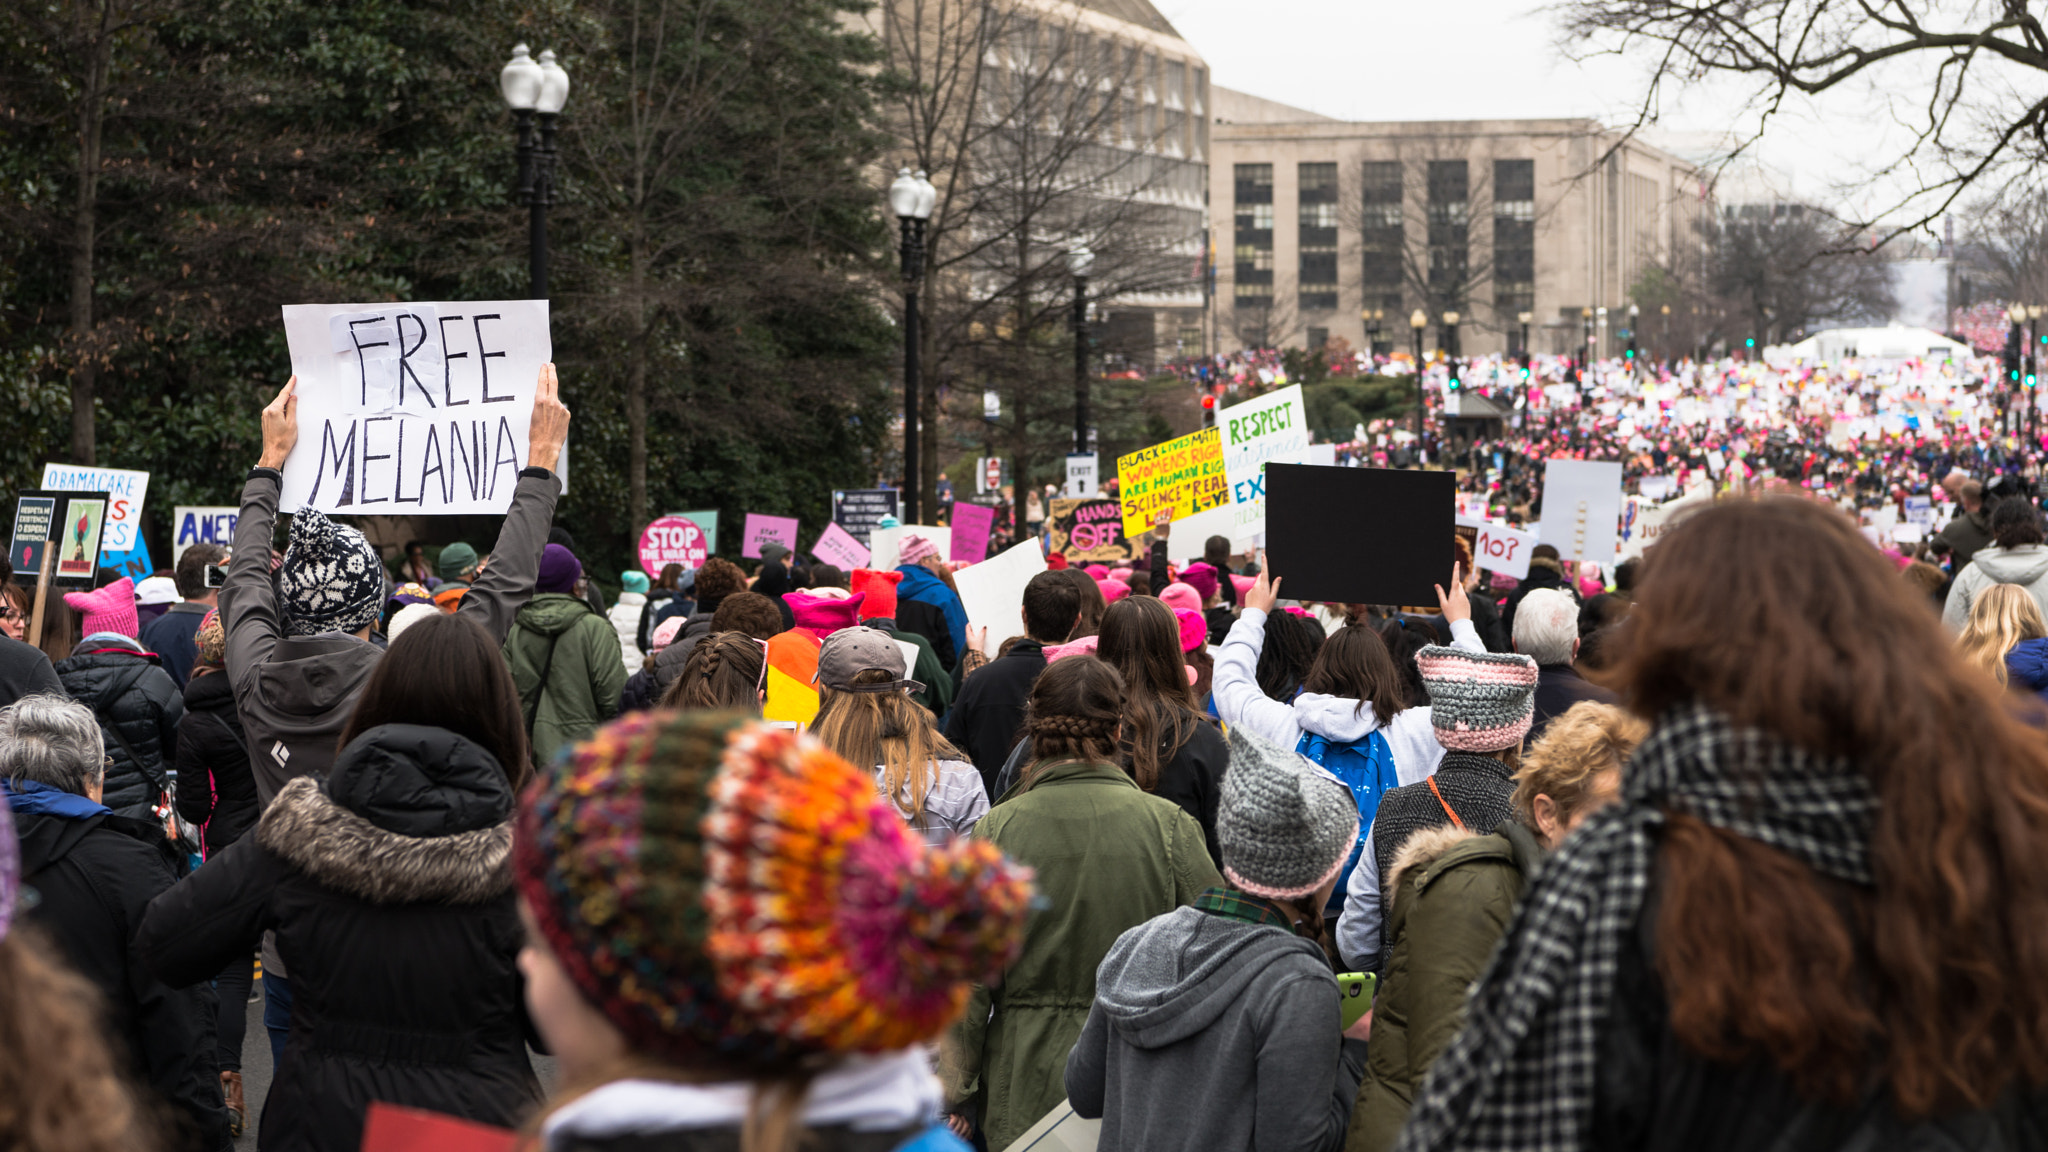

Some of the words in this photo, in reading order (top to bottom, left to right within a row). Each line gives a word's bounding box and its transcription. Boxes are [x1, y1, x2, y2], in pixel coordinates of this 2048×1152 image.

[349, 313, 515, 408] FREE
[1229, 402, 1292, 446] RESPECT
[308, 416, 519, 508] MELANIA
[1120, 446, 1160, 471] BLACK
[1161, 437, 1190, 454] LIVES
[1191, 427, 1220, 446] MATT
[1071, 466, 1091, 476] EXIT
[1126, 450, 1187, 484] WOMENS
[48, 470, 136, 497] OBAMACARE
[1124, 481, 1148, 499] ARE
[1154, 465, 1198, 489] HUMAN
[1126, 485, 1181, 517] SCIENCE
[1193, 474, 1228, 497] REAL
[1234, 474, 1266, 504] EX
[21, 506, 43, 515] RESPETA
[1075, 503, 1122, 523] HANDS
[17, 524, 23, 532] O
[23, 524, 47, 533] ESPERA
[178, 512, 239, 545] AMER
[647, 527, 699, 549] STOP
[1071, 522, 1122, 551] OFF
[1641, 524, 1670, 539] JUS
[641, 549, 659, 560] THE
[662, 549, 686, 560] WAR
[688, 548, 705, 560] ON
[1479, 532, 1519, 561] 10?
